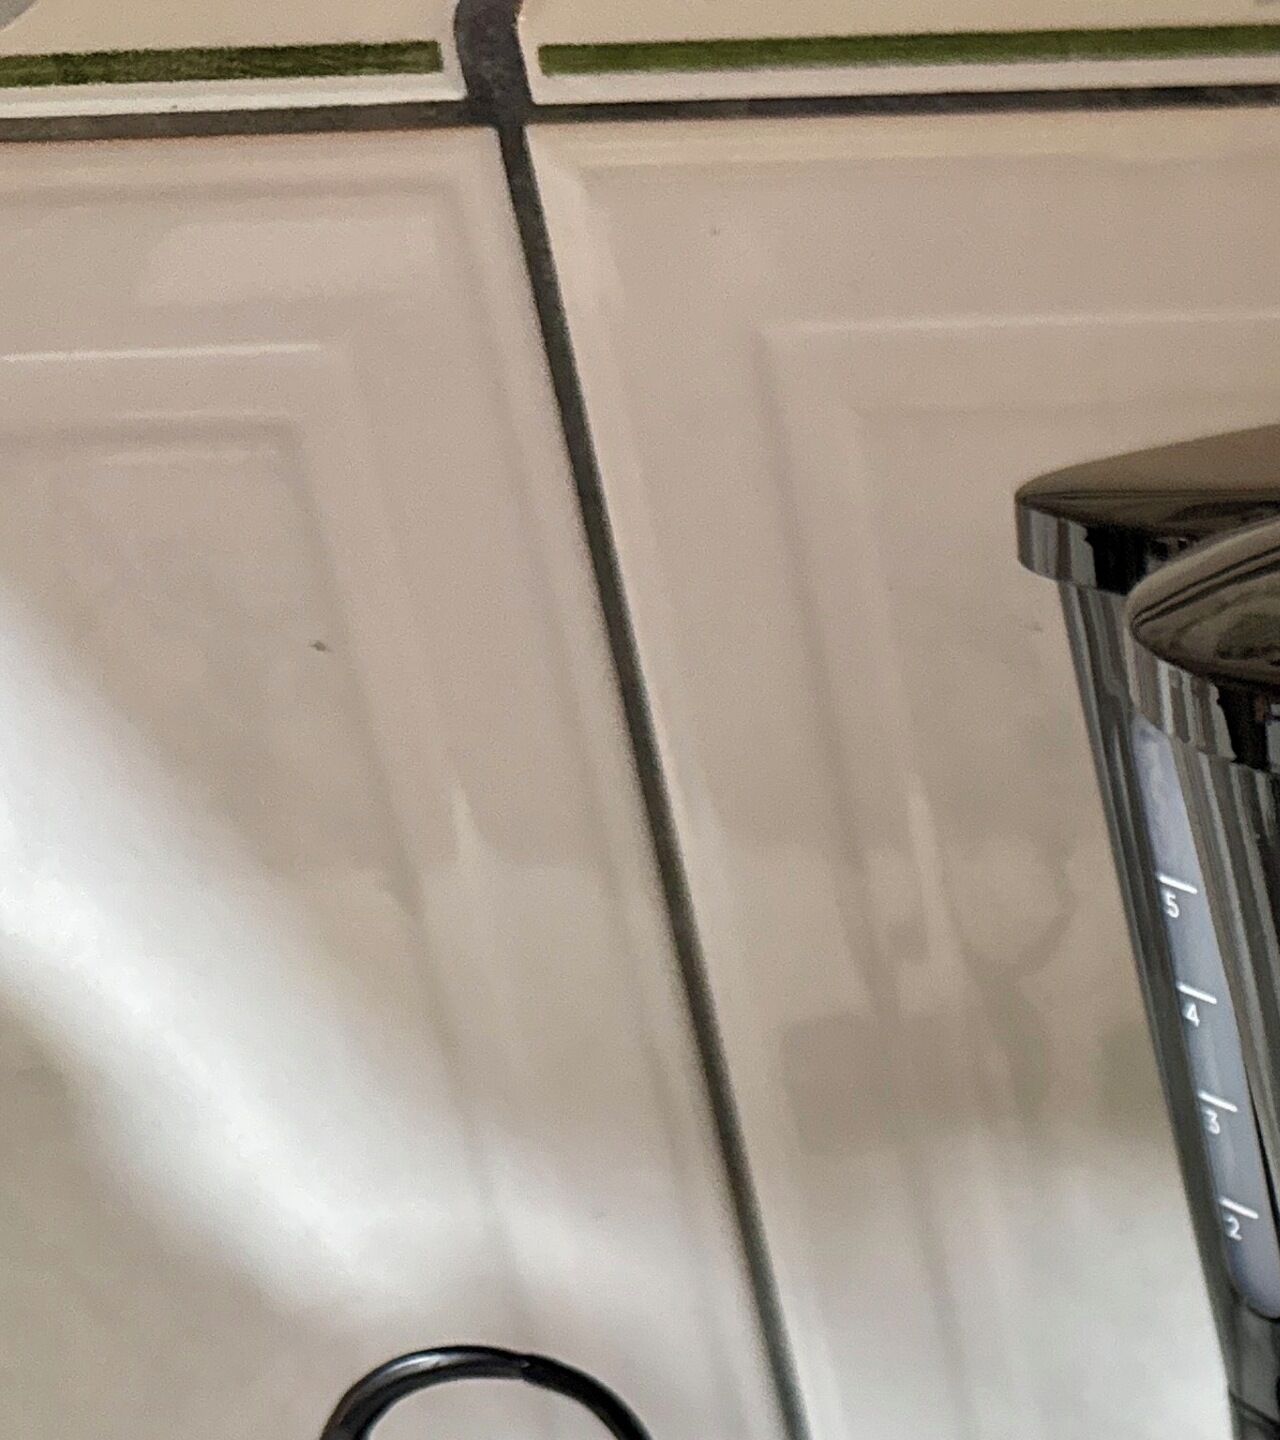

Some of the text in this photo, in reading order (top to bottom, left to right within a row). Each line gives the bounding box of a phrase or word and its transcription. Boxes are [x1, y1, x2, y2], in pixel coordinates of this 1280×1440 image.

[1163, 893, 1180, 918] 5
[1184, 1003, 1200, 1027] 4
[1205, 1109, 1220, 1135] 3
[1225, 1216, 1242, 1240] 2
